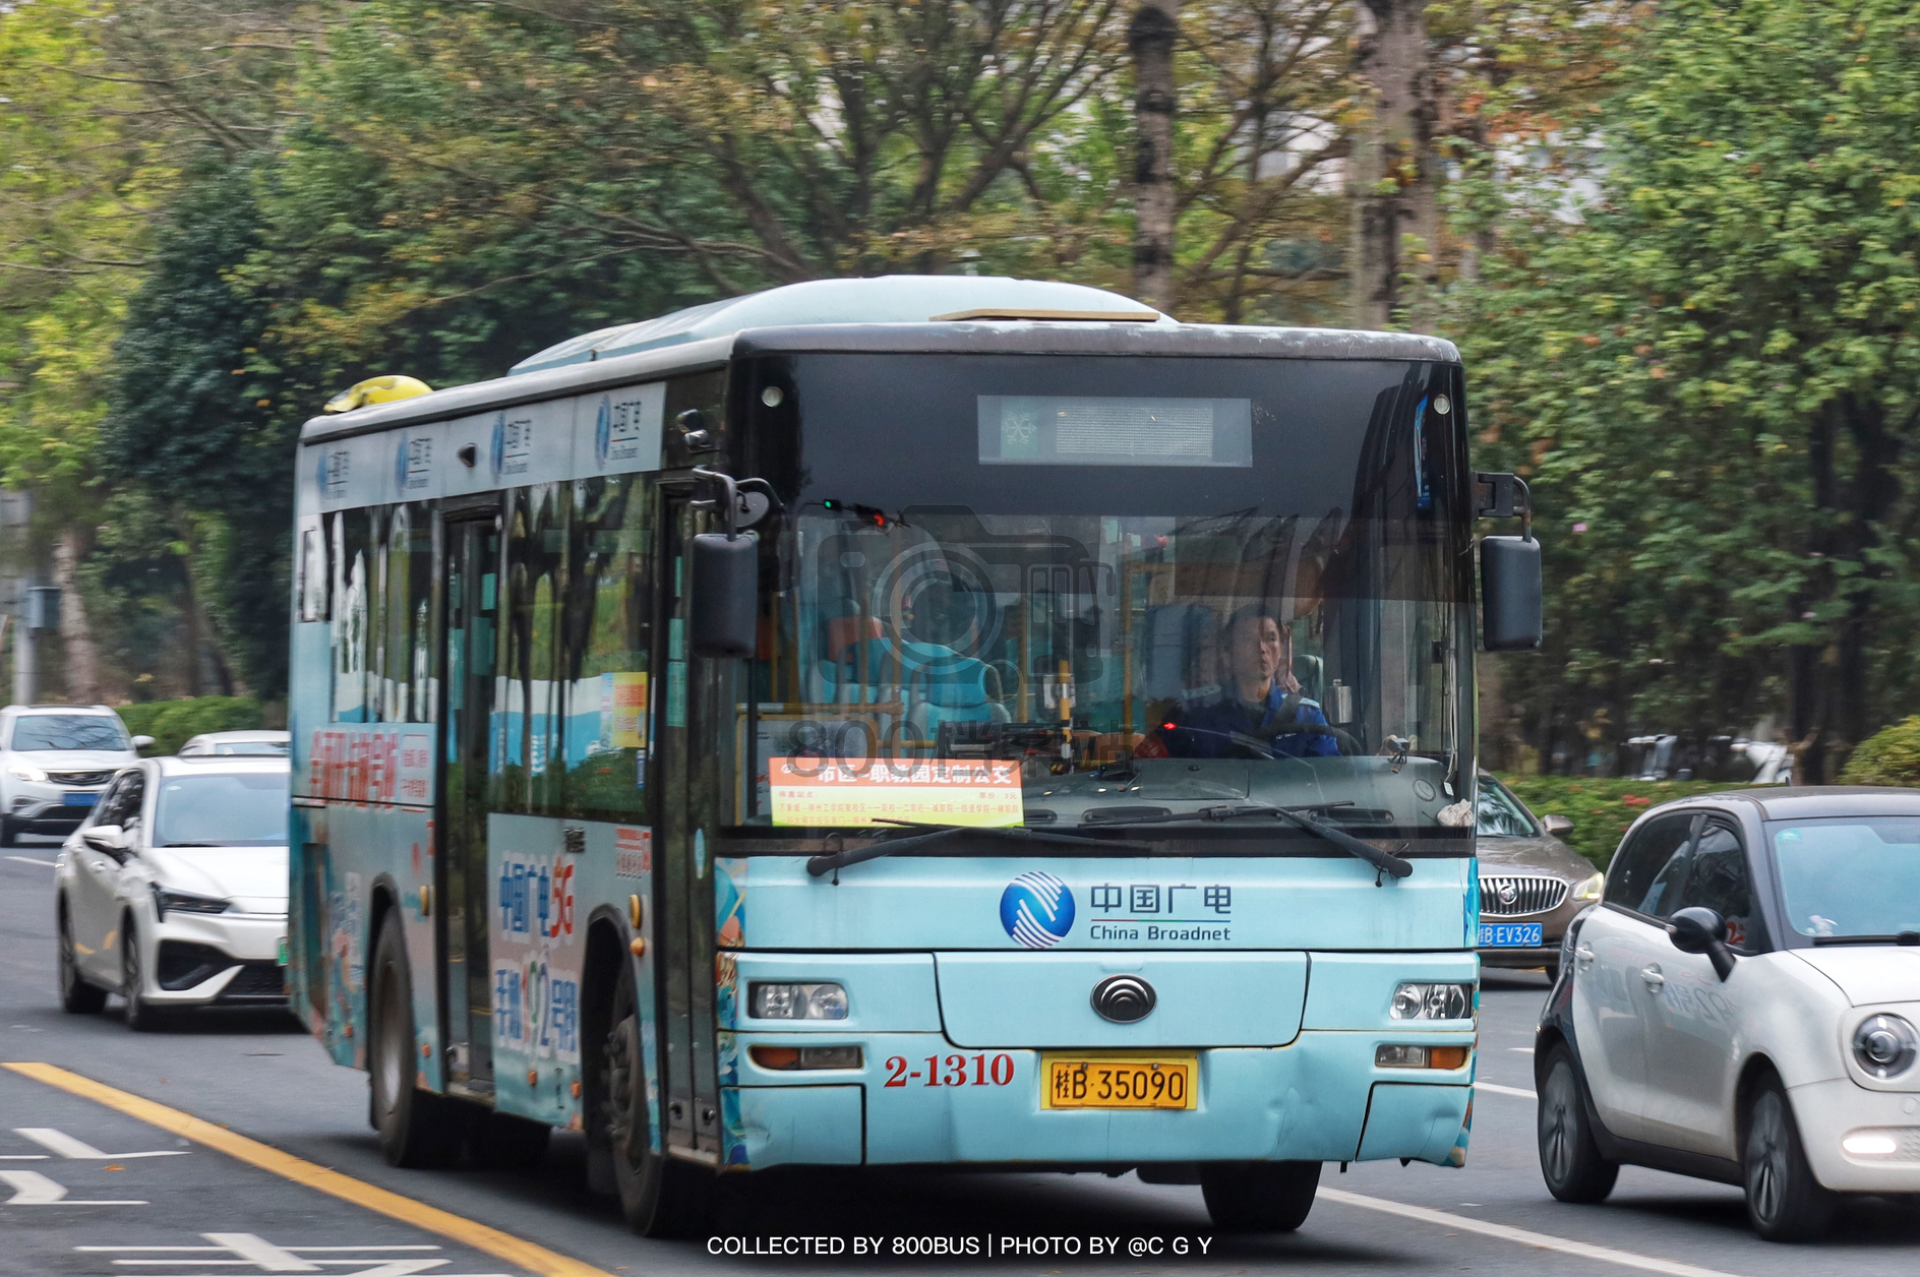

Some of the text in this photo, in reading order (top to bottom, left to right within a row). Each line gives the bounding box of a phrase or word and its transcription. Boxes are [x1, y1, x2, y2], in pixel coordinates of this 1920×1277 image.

[1091, 883, 1232, 914] 中国广电
[1091, 925, 1231, 941] China Broadnet
[884, 1053, 1014, 1088] 2-1310
[1056, 1069, 1184, 1101] 桂B·35090
